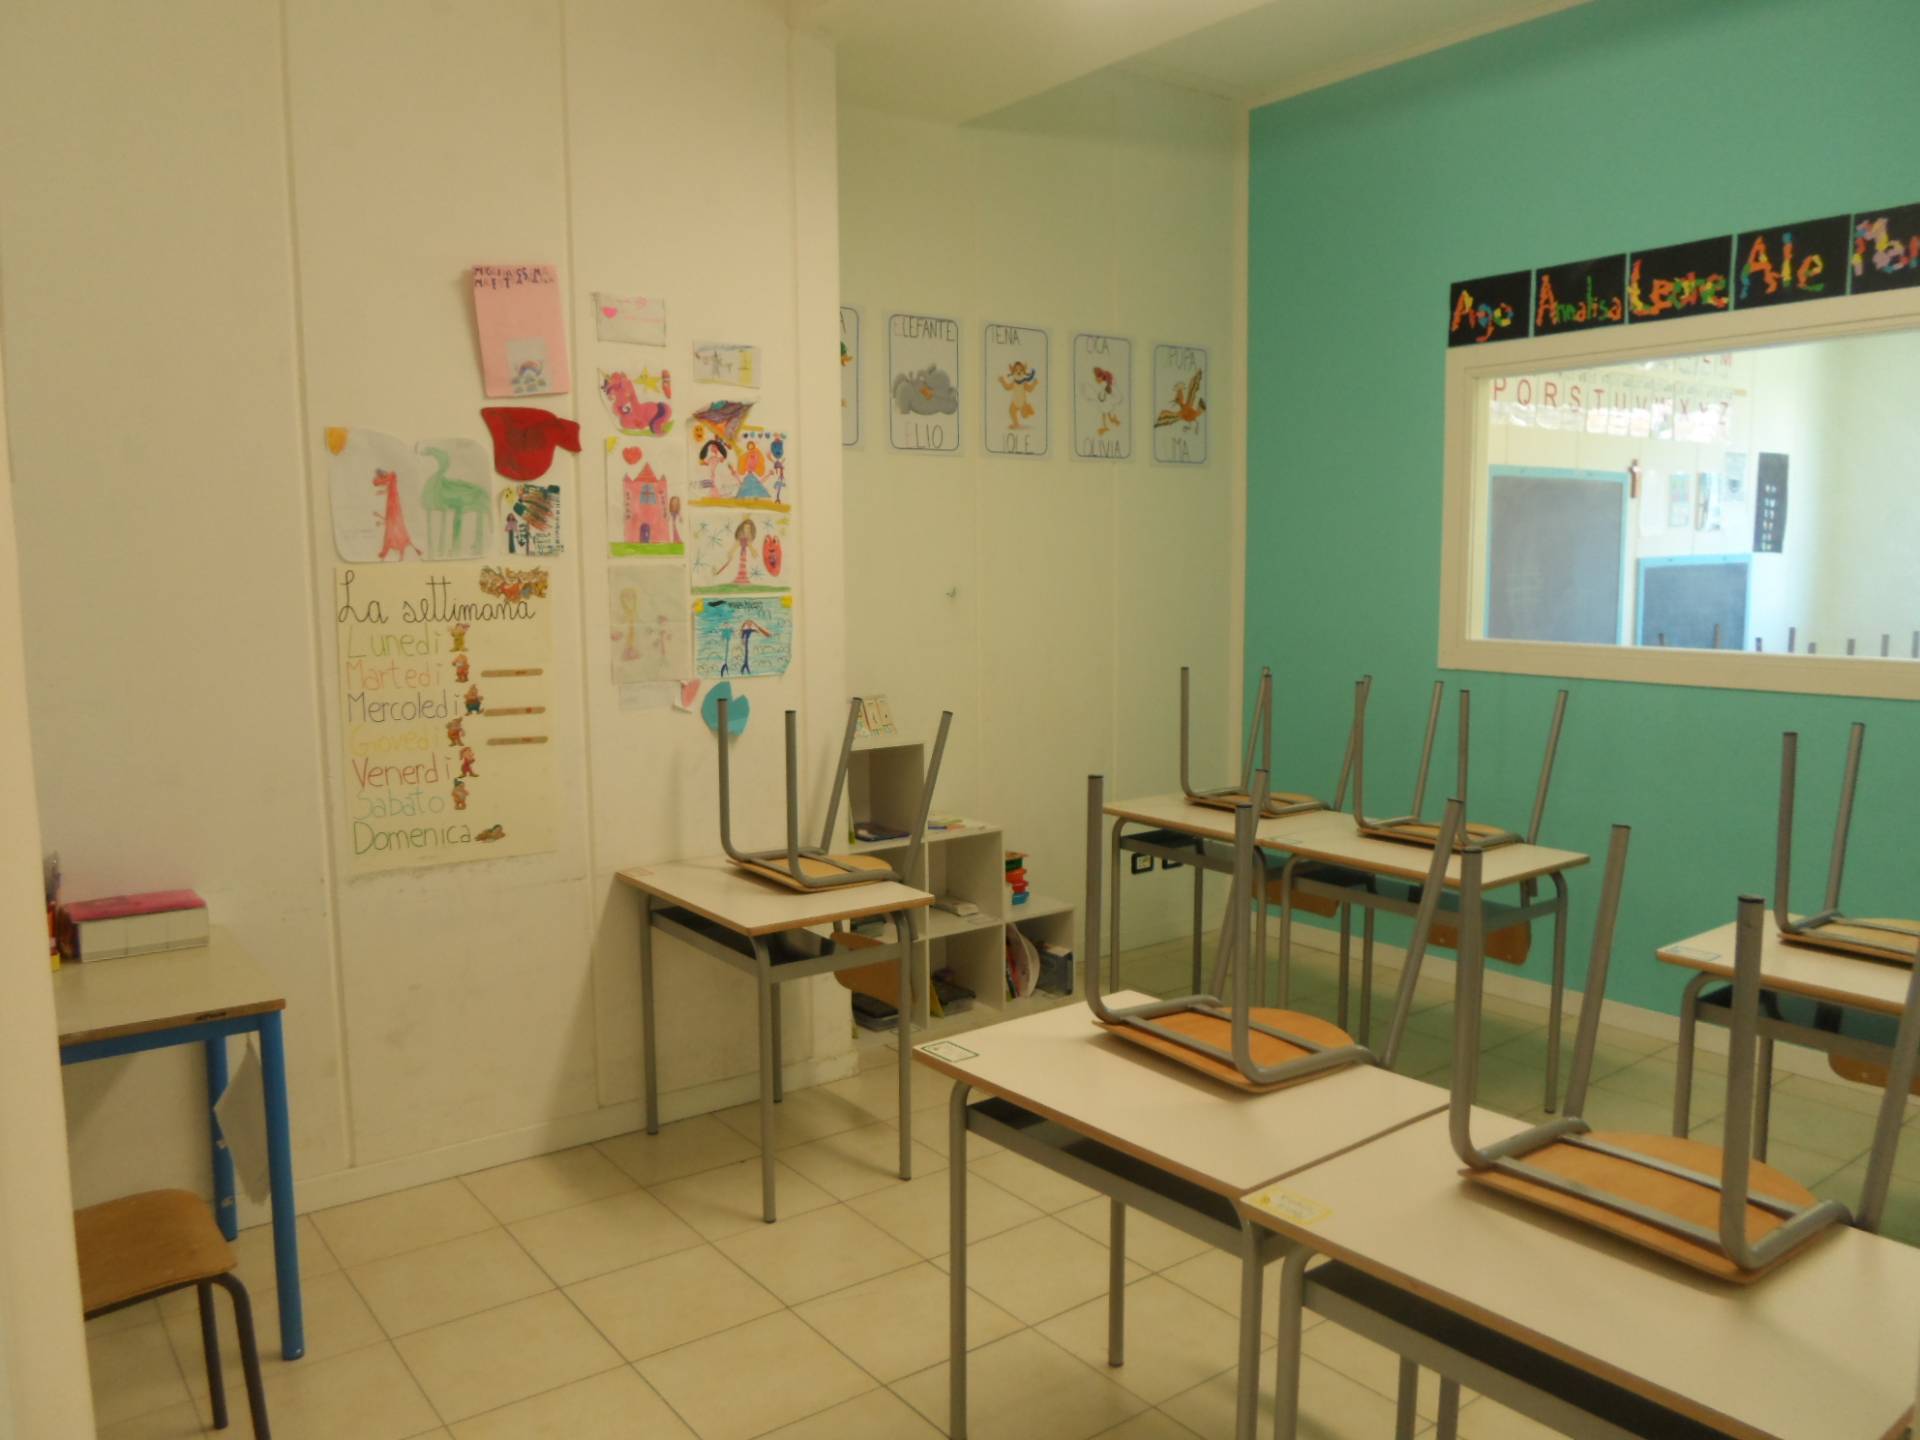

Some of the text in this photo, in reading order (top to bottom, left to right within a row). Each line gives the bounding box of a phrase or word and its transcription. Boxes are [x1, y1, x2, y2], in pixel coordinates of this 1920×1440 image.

[1451, 290, 1514, 342] Ago
[1493, 377, 1507, 401] P
[1516, 379, 1532, 406] Q
[1544, 382, 1558, 408] R
[1570, 385, 1581, 412] S
[1593, 388, 1605, 410] T
[338, 569, 536, 624] La settimana
[352, 787, 446, 821] Sabato
[353, 820, 473, 855] Domenica
